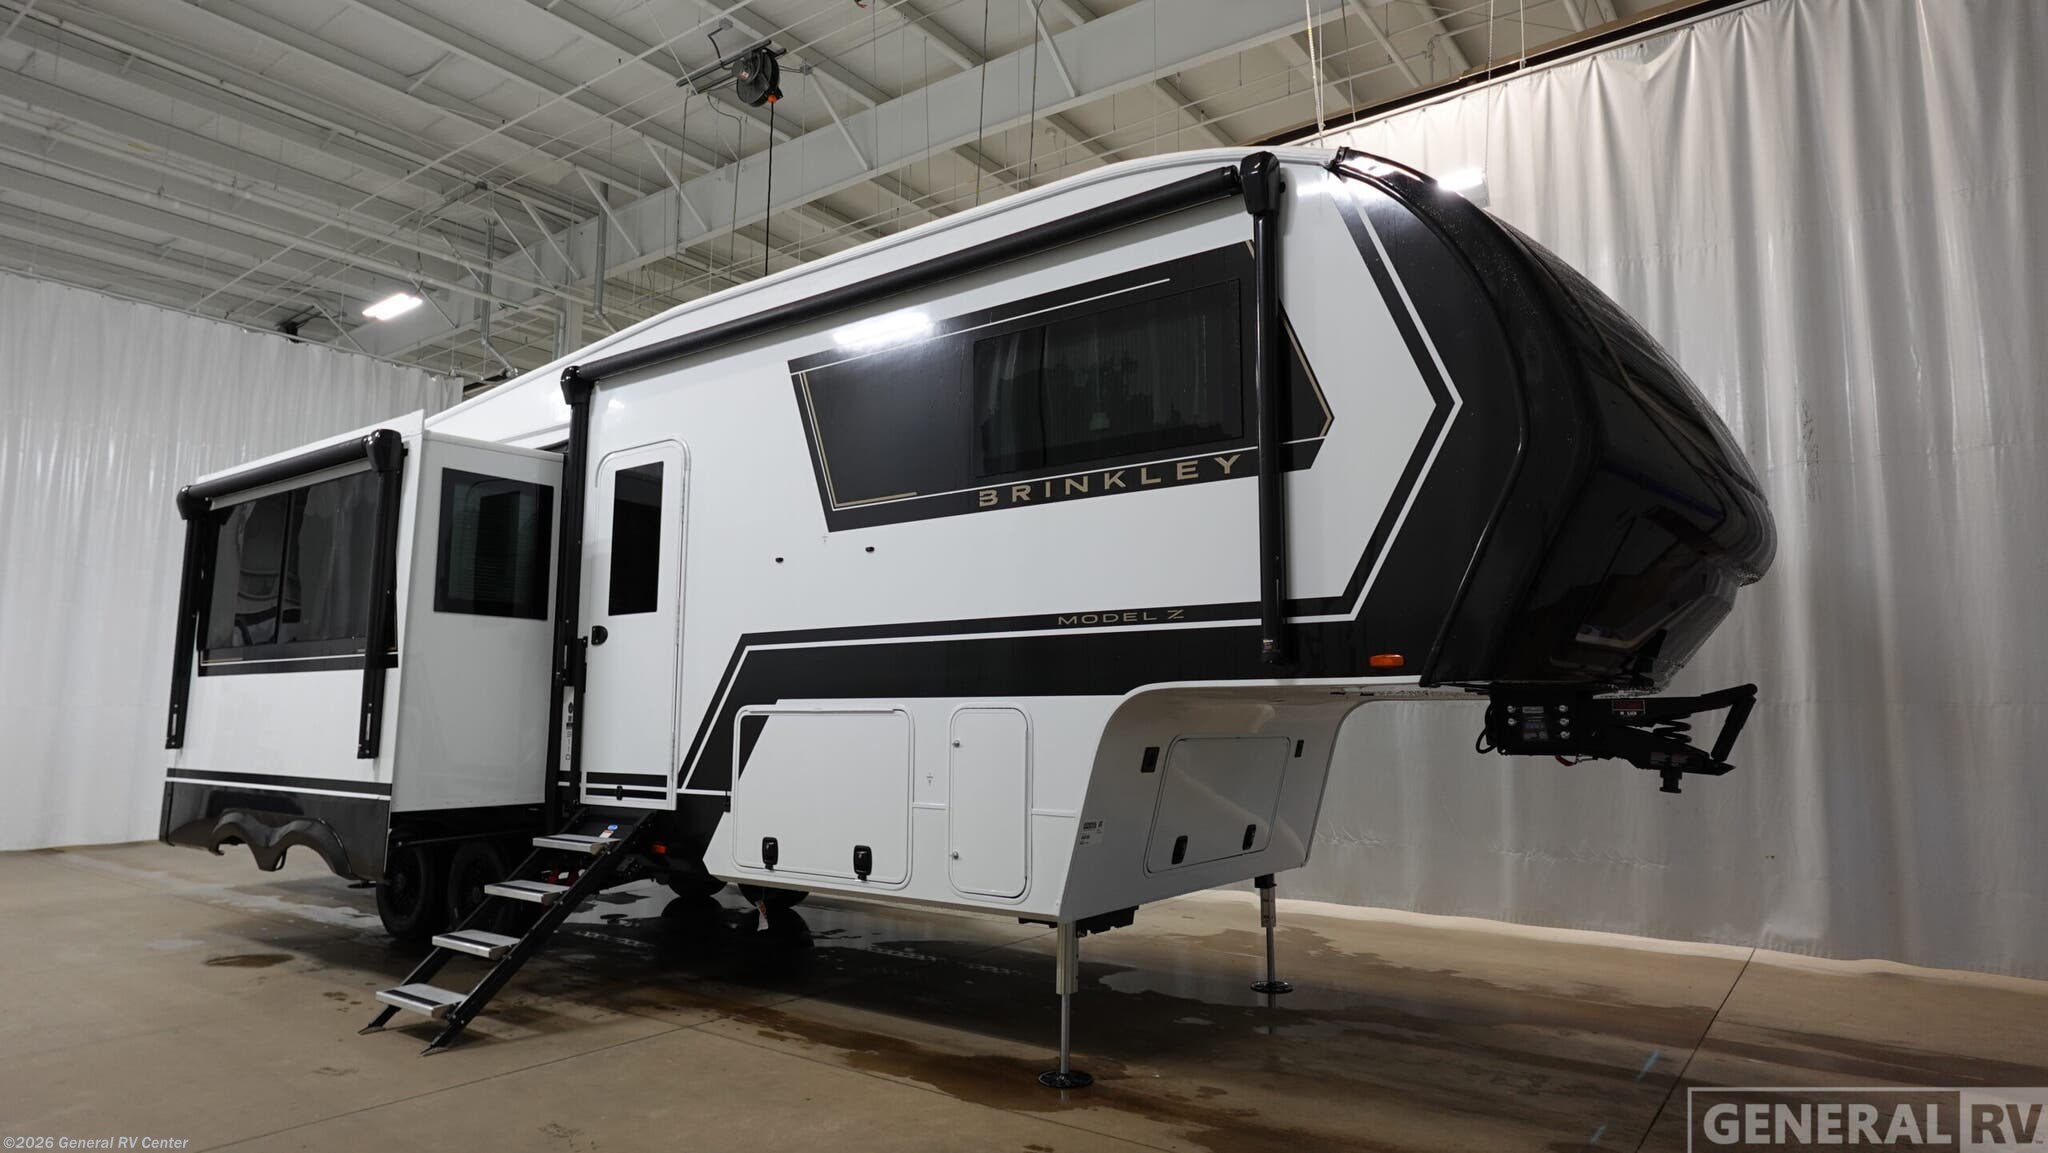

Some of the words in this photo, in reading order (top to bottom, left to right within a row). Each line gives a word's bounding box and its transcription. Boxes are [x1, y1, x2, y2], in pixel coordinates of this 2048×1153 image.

[978, 454, 1240, 507] BRINKLEY
[1058, 612, 1157, 625] MODEL
[1167, 609, 1185, 620] Z
